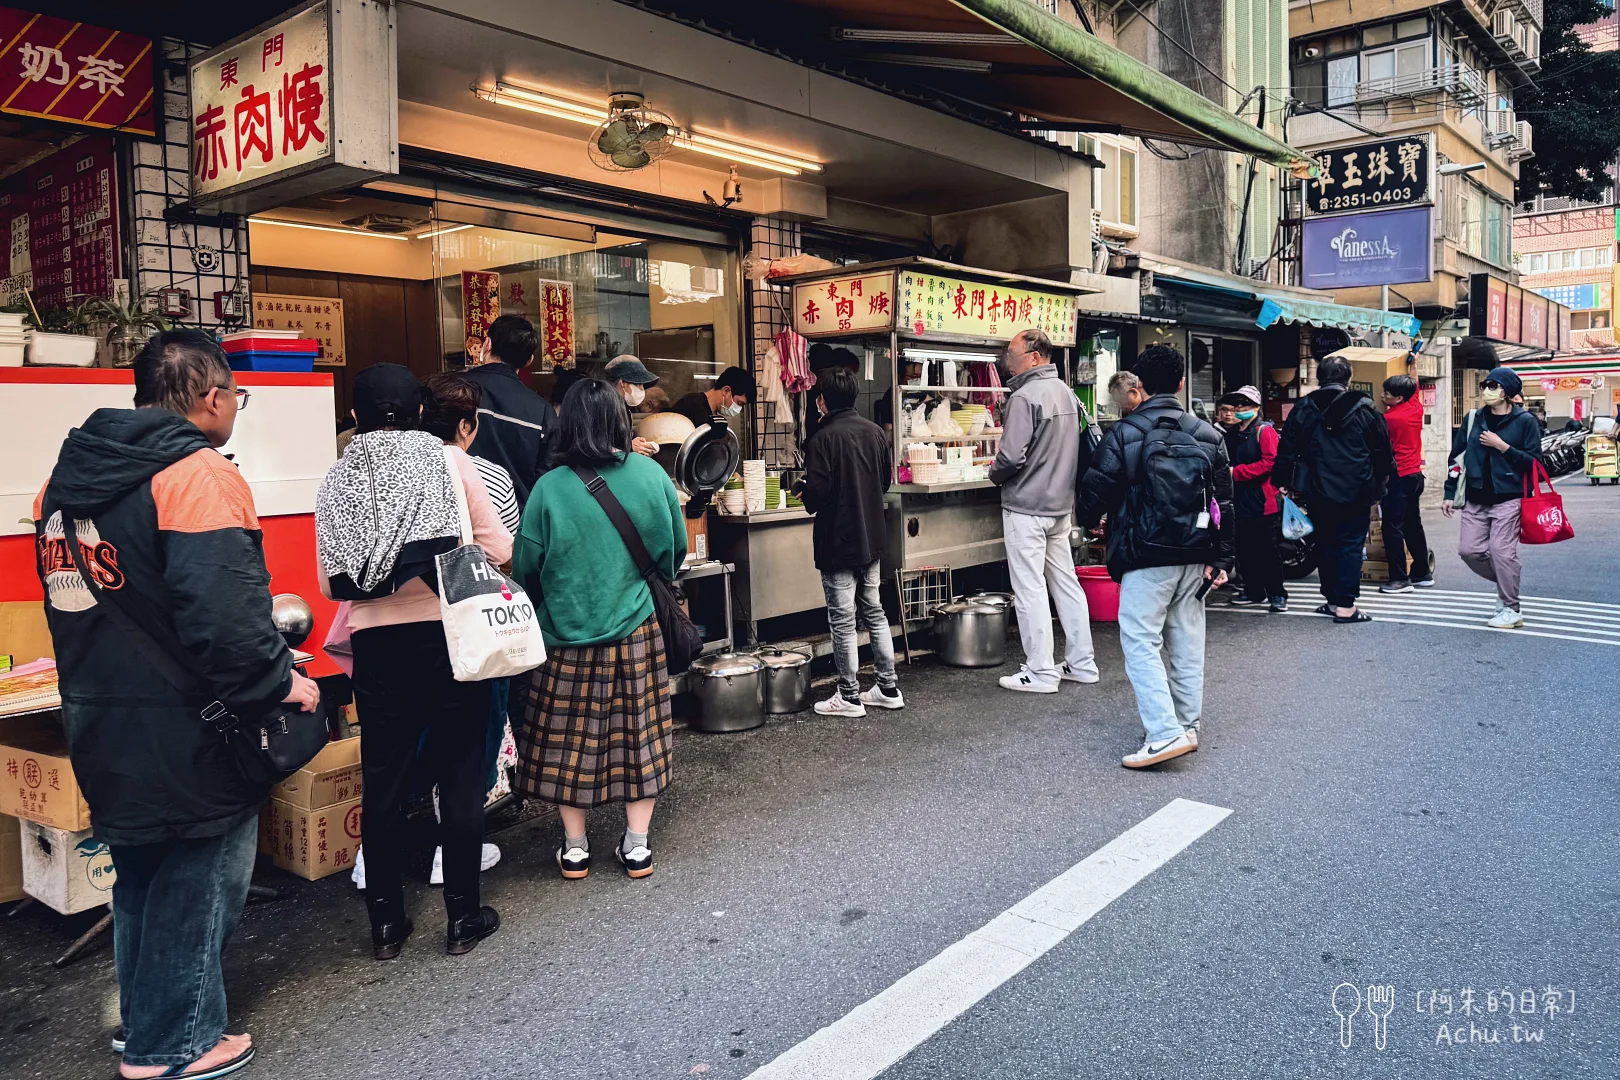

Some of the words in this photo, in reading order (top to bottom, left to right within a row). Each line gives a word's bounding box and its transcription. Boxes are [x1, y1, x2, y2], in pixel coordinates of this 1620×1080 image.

[17, 41, 126, 97] 奶茶
[219, 32, 285, 92] 東門
[194, 61, 325, 182] 赤肉焿
[1311, 141, 1422, 197] 翠玉珠寶
[468, 273, 484, 338] 恭喜發財
[802, 291, 890, 325] 赤肉焿
[827, 279, 863, 302] 東門
[952, 283, 1033, 326] 東門赤肉焿
[549, 288, 567, 360] 開市大吉
[838, 318, 852, 330] 55
[989, 324, 998, 335] 55
